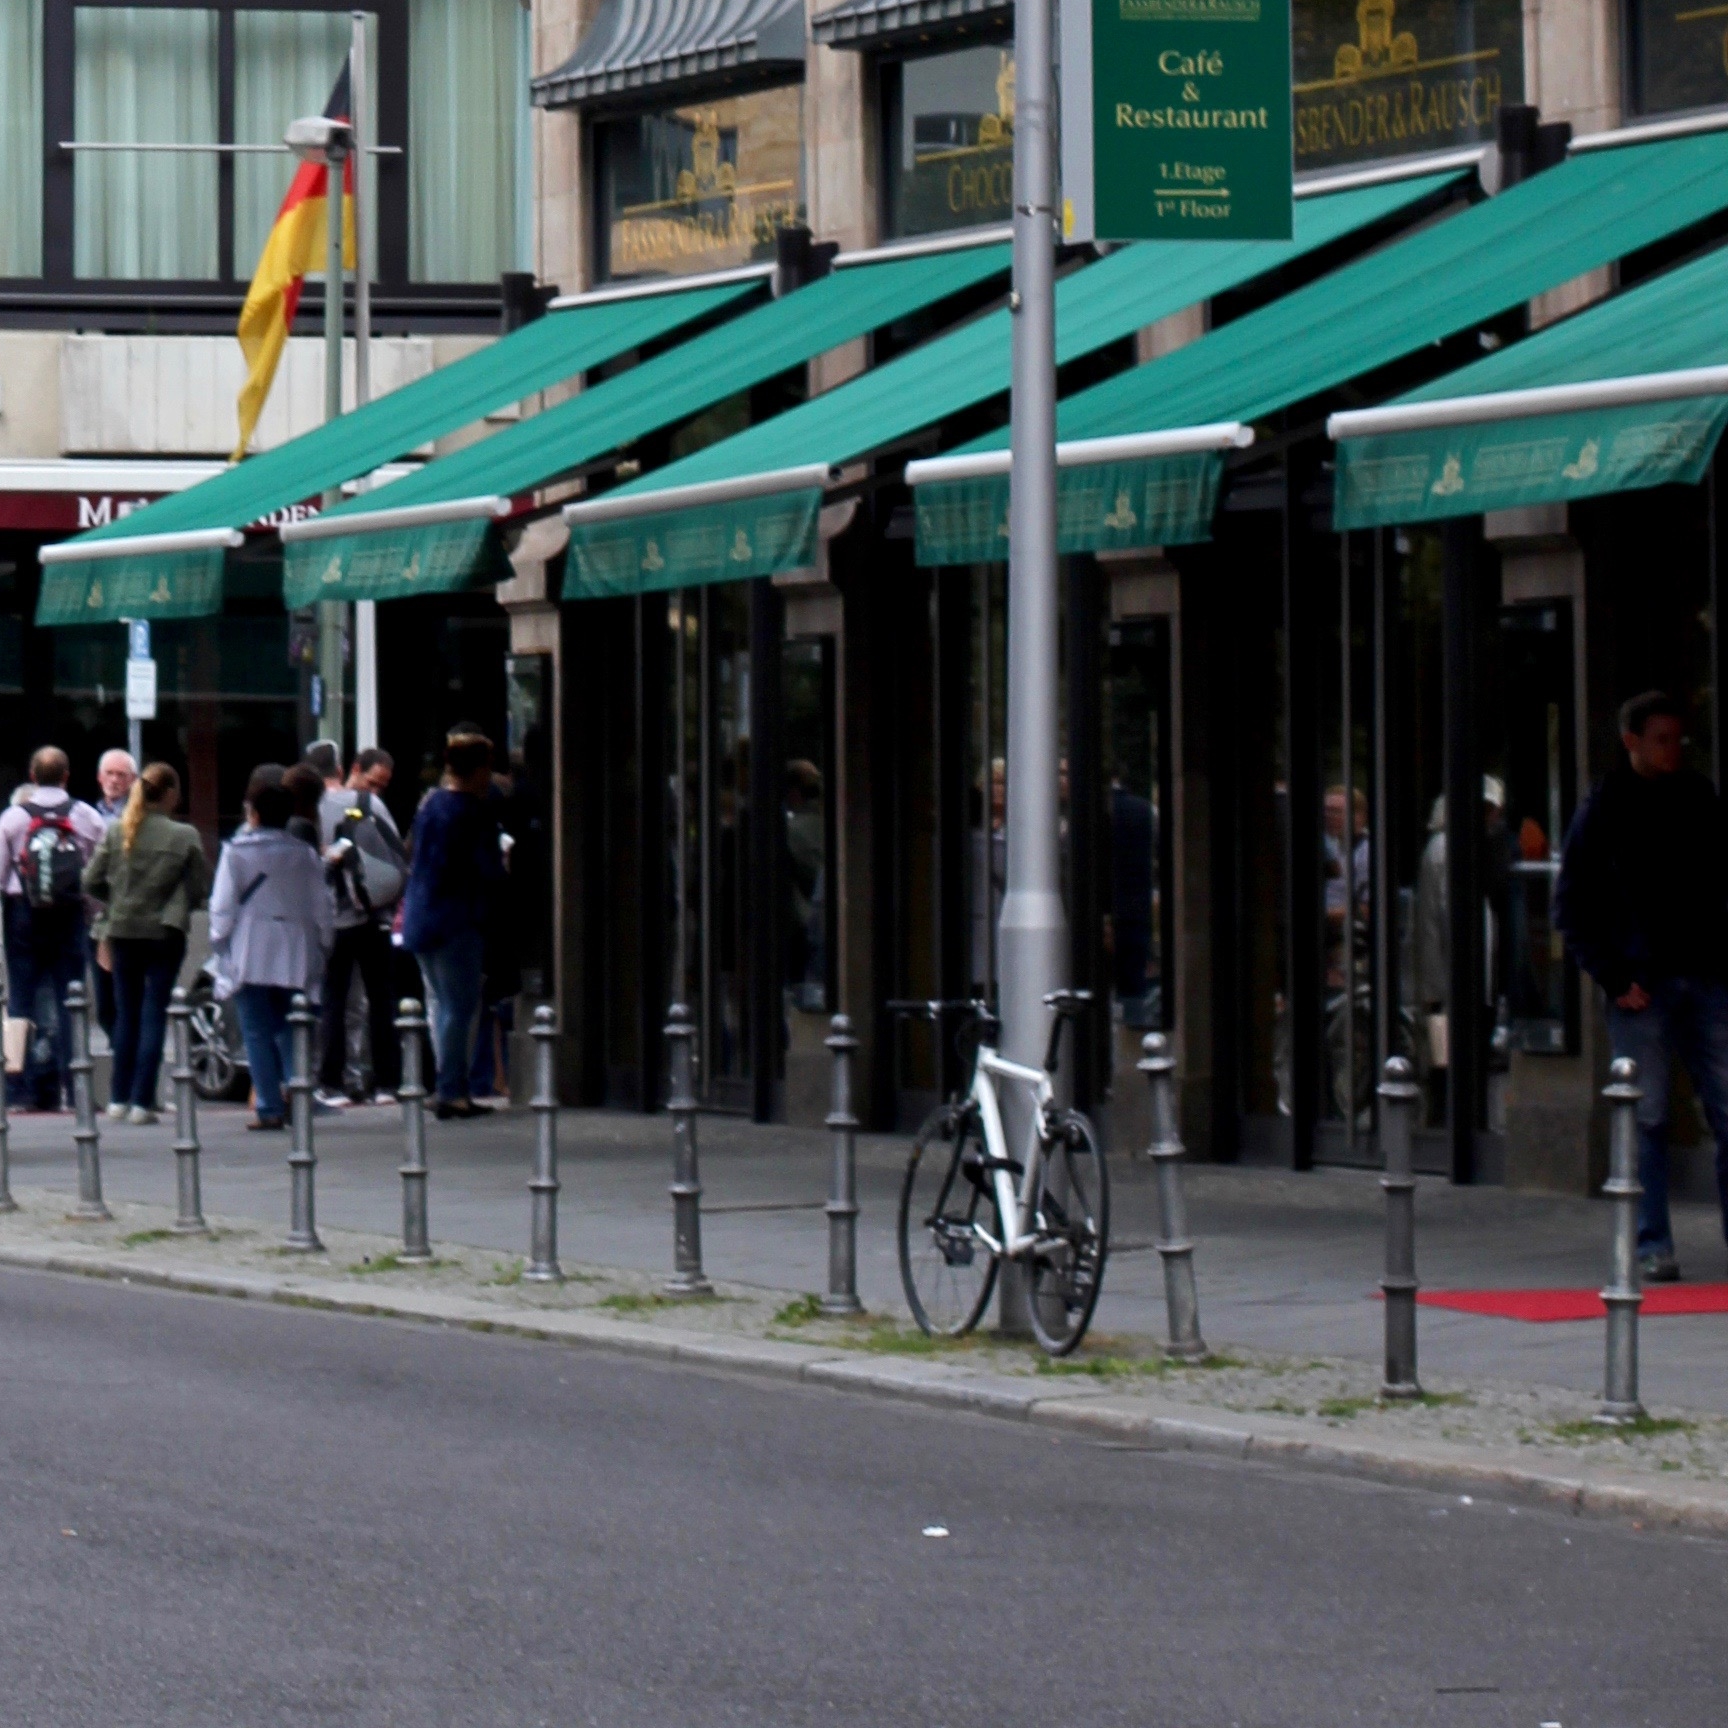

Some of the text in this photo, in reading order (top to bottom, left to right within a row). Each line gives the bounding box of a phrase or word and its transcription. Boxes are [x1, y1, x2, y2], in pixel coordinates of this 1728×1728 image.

[1158, 49, 1223, 76] Café
[1181, 81, 1200, 102] &
[1115, 103, 1268, 129] Restaurant
[947, 160, 1013, 213] CHOCO
[1180, 200, 1231, 218] Floor
